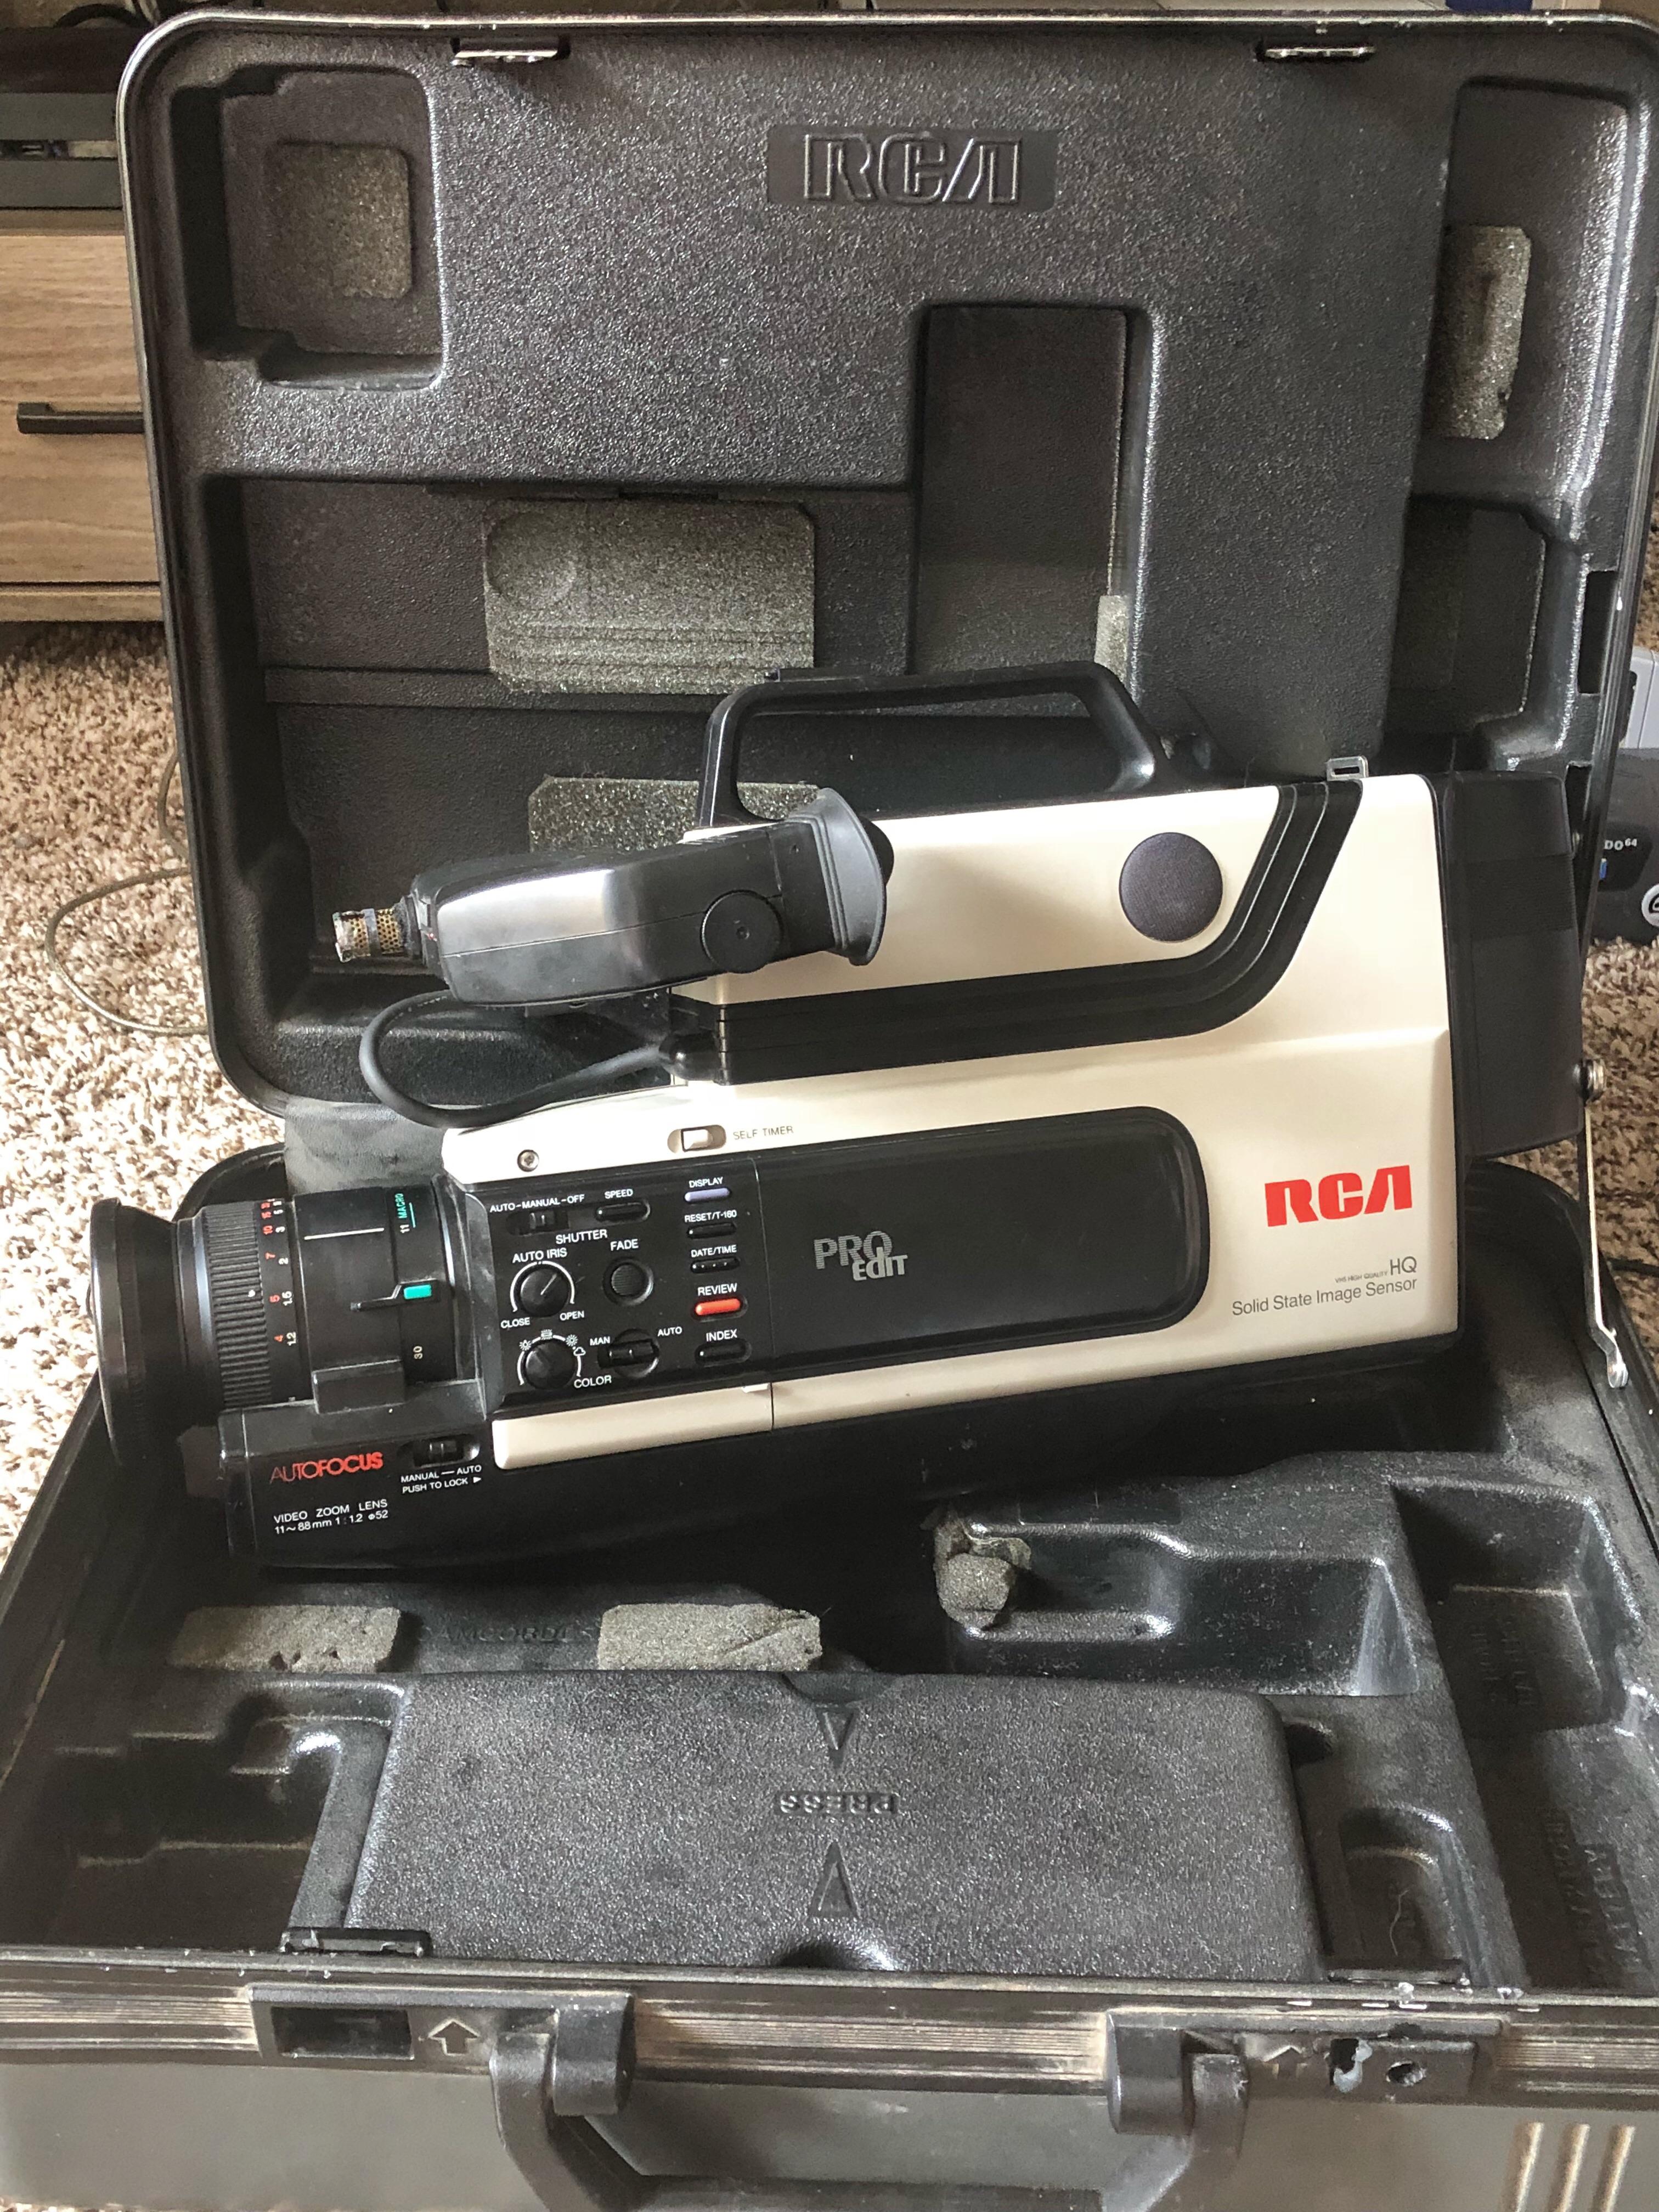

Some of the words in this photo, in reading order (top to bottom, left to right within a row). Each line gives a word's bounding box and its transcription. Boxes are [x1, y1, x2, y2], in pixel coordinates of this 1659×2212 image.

[804, 132, 1021, 204] RCA
[733, 1129, 758, 1140] SELF
[763, 1126, 793, 1136] TIMER
[689, 1177, 723, 1188] DISPLAY
[605, 1189, 633, 1199] SPEED
[1265, 1165, 1413, 1227] RCA
[395, 1193, 408, 1218] MACRO
[685, 1210, 737, 1222] RESET/T-160
[556, 1229, 607, 1245] SHUTTER
[610, 1239, 639, 1251] FADE
[512, 1250, 544, 1263] AUTO
[546, 1248, 567, 1259] IRIS
[691, 1244, 737, 1257] DATE/TIME
[814, 1231, 893, 1269] PRO
[1390, 1256, 1417, 1276] HQ
[698, 1283, 737, 1296] REVIEW
[1232, 1298, 1269, 1316] Solid
[1273, 1293, 1312, 1310] State
[1317, 1287, 1362, 1304] Image
[1365, 1278, 1418, 1296] Sensor
[500, 1317, 530, 1329] CLOSE
[560, 1311, 584, 1321] OPEN
[590, 1336, 611, 1346] MAN
[658, 1327, 682, 1336] AUTO
[706, 1329, 737, 1341] INDEX
[574, 1375, 612, 1389] COLOR
[269, 1452, 383, 1484] AUTOFOCUS
[401, 1471, 439, 1483] MANUAL
[456, 1465, 482, 1475] AUTO
[402, 1483, 427, 1494] PUSH
[444, 1478, 468, 1487] LOCK
[274, 1511, 308, 1523] VIDEO
[316, 1504, 349, 1517] ZOOM
[358, 1499, 388, 1511] LENS
[780, 1793, 897, 1815] PRESS
